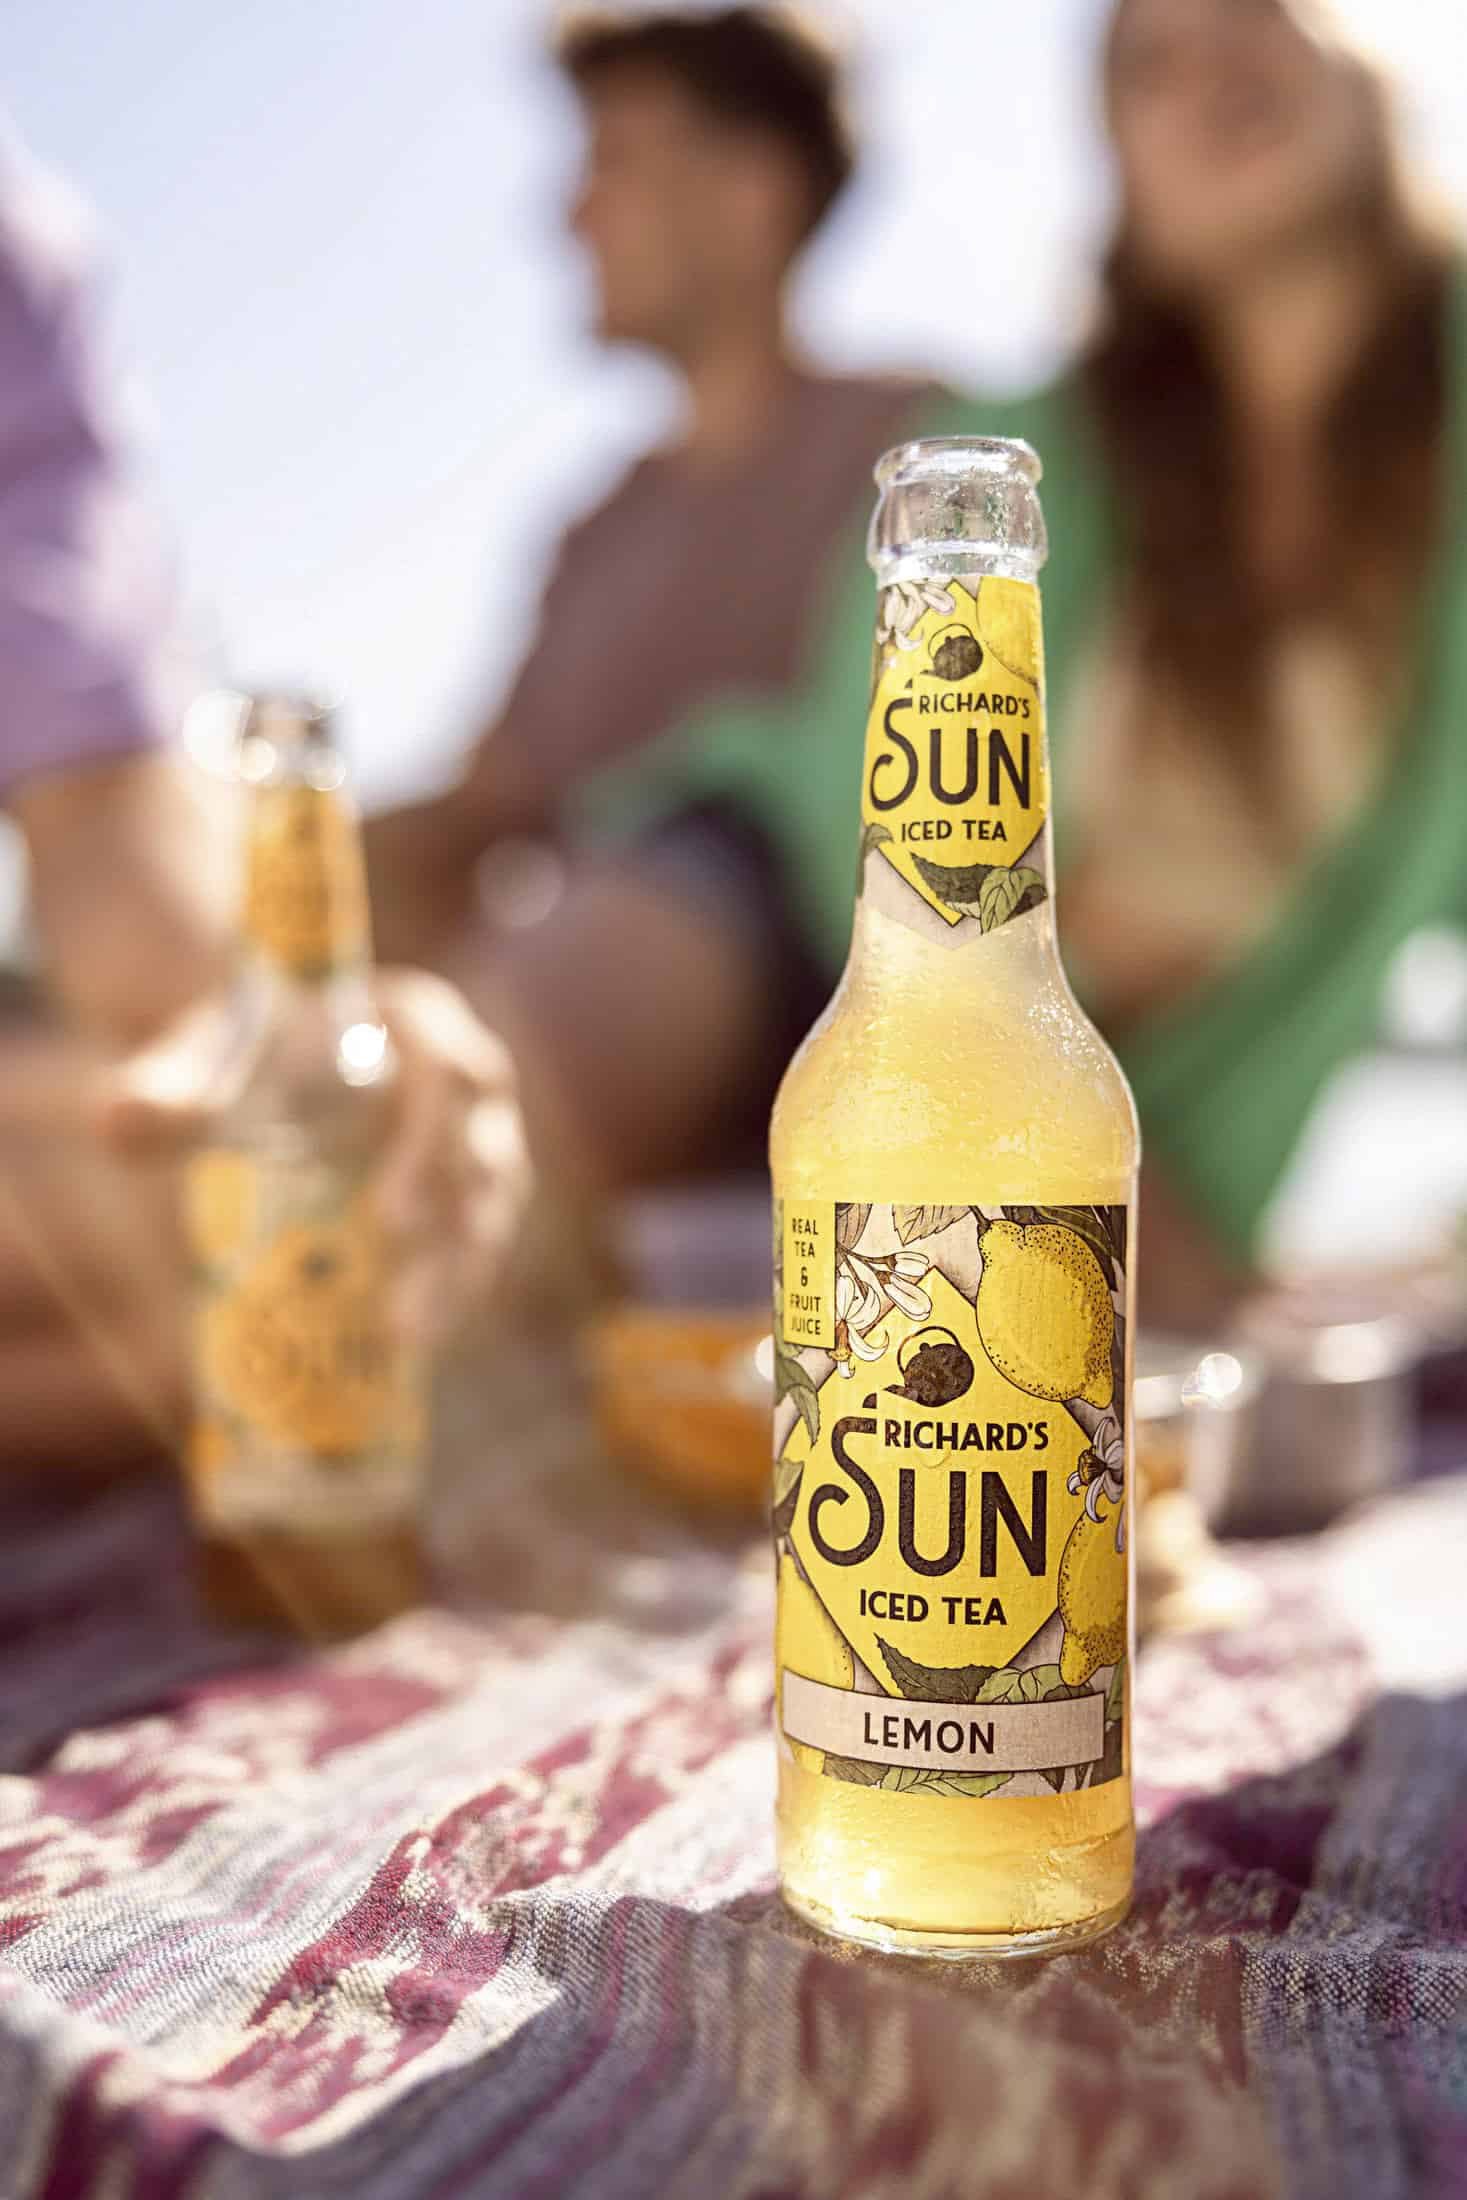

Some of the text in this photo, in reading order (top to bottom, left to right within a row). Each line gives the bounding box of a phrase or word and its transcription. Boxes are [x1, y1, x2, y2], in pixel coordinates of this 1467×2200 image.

[920, 693, 1030, 719] RICHARD'S
[870, 697, 1030, 811] SUN
[901, 820, 1008, 842] ICED TEA
[792, 1218, 818, 1235] REAL
[795, 1241, 815, 1257] TEA
[790, 1294, 821, 1312] FRUIT
[885, 1419, 1048, 1451] RICHARD'S
[808, 1416, 1047, 1577] SUN
[860, 1588, 1008, 1625] ICED TEA
[864, 1711, 995, 1754] LEMON
